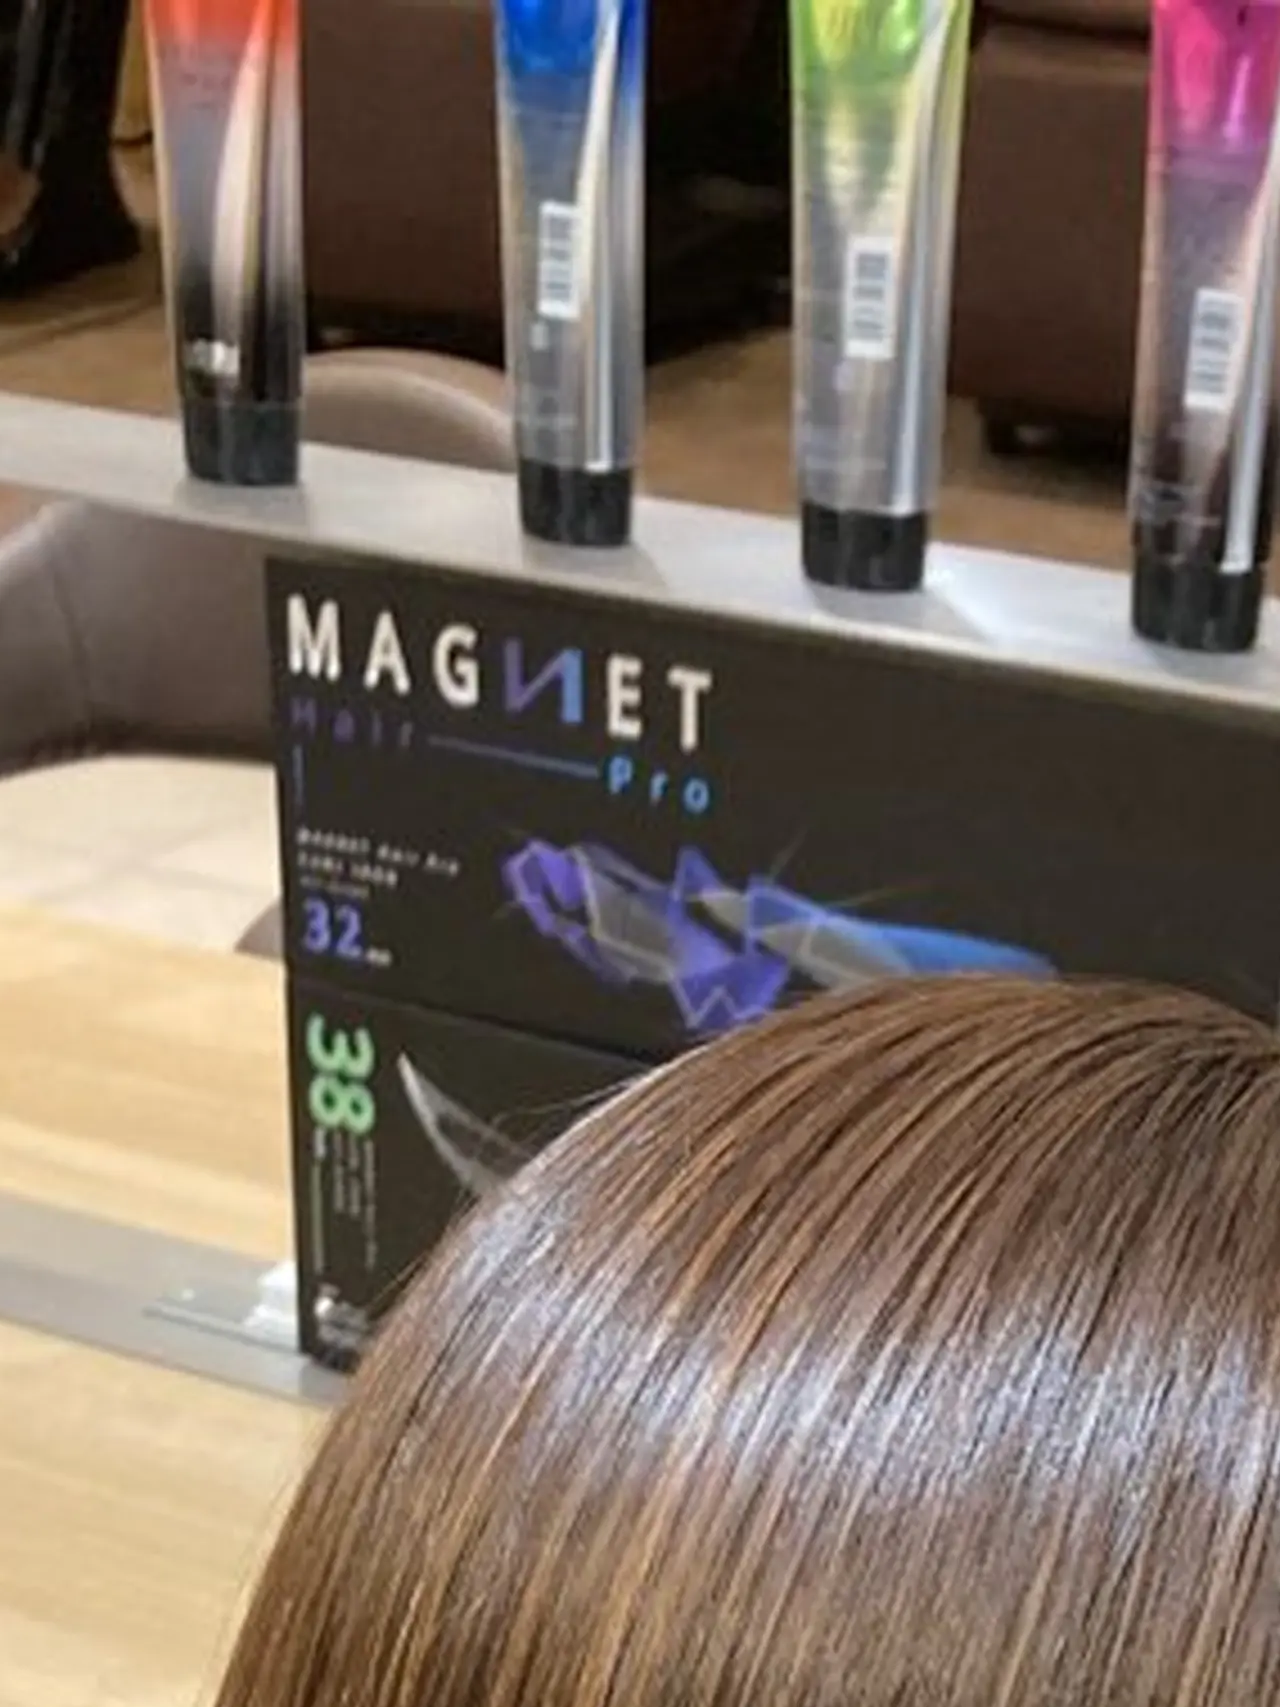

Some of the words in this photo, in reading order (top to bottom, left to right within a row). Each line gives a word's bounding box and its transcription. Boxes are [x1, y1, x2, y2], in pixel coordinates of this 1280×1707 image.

[608, 754, 710, 814] Pro
[303, 898, 363, 958] 32
[306, 1012, 376, 1134] 38
